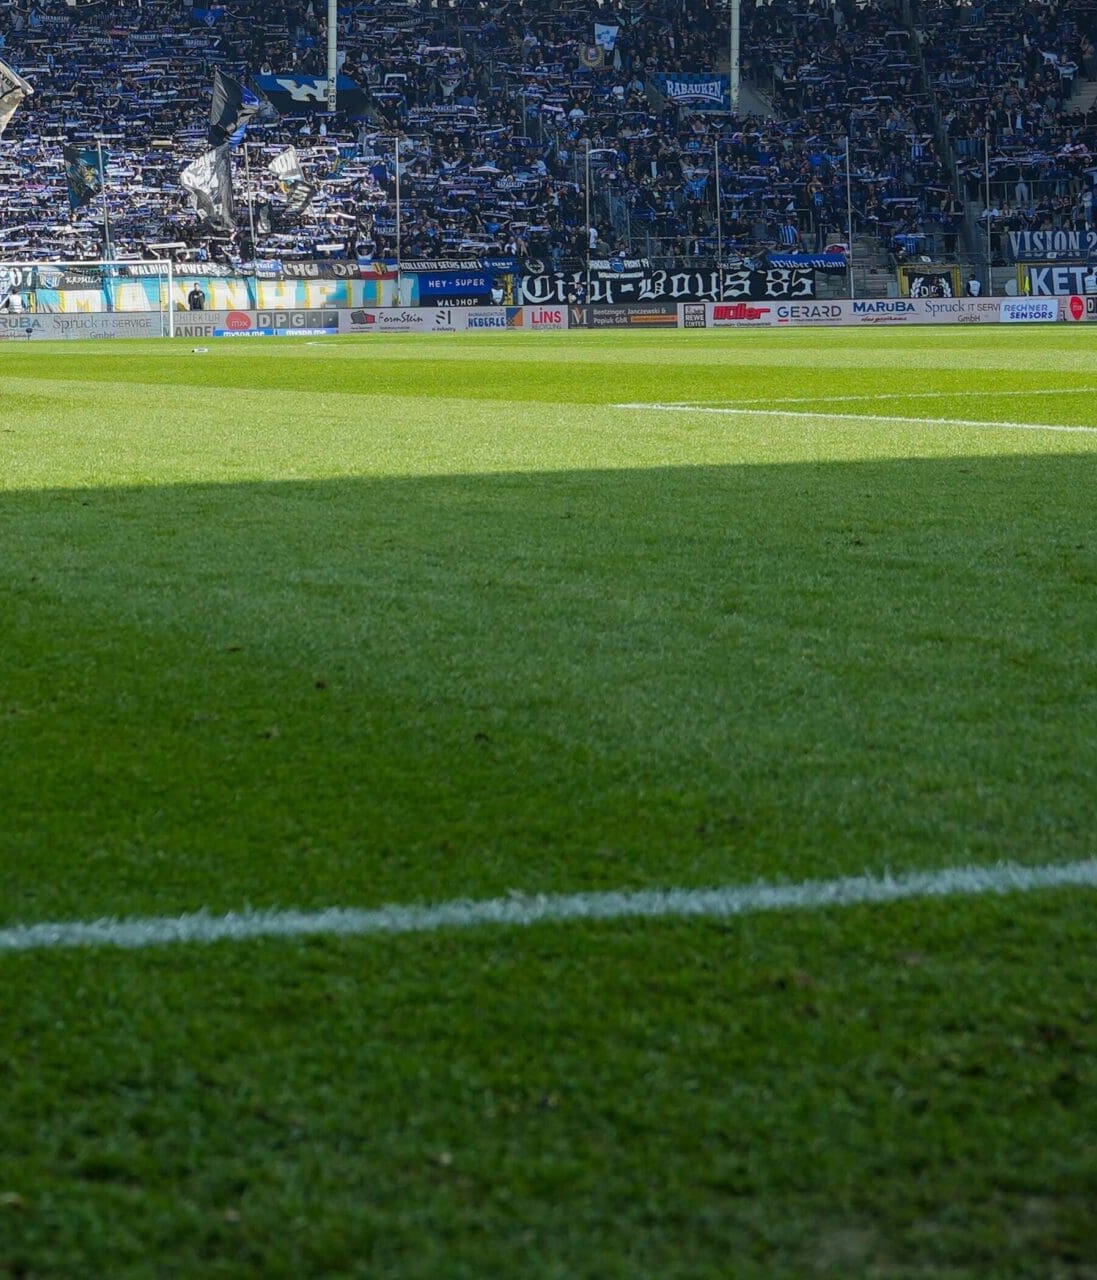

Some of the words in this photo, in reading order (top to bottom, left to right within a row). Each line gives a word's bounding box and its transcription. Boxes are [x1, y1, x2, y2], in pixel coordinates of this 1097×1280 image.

[666, 80, 721, 98] RABAUKEN
[1008, 230, 1081, 257] VISION
[400, 261, 437, 270] KOLLEKTIV
[438, 261, 460, 269] SECHS
[771, 260, 809, 268] Wilder
[813, 260, 846, 268] Mann
[428, 279, 446, 288] HEY
[455, 278, 485, 287] SUPER
[1031, 266, 1097, 296] KET
[437, 298, 478, 307] WALDHOF
[925, 300, 964, 317] Spruck
[978, 304, 1000, 312] SERVI
[777, 306, 842, 318] GERARD
[53, 314, 97, 333] Spruck
[163, 325, 216, 337] MANDE
